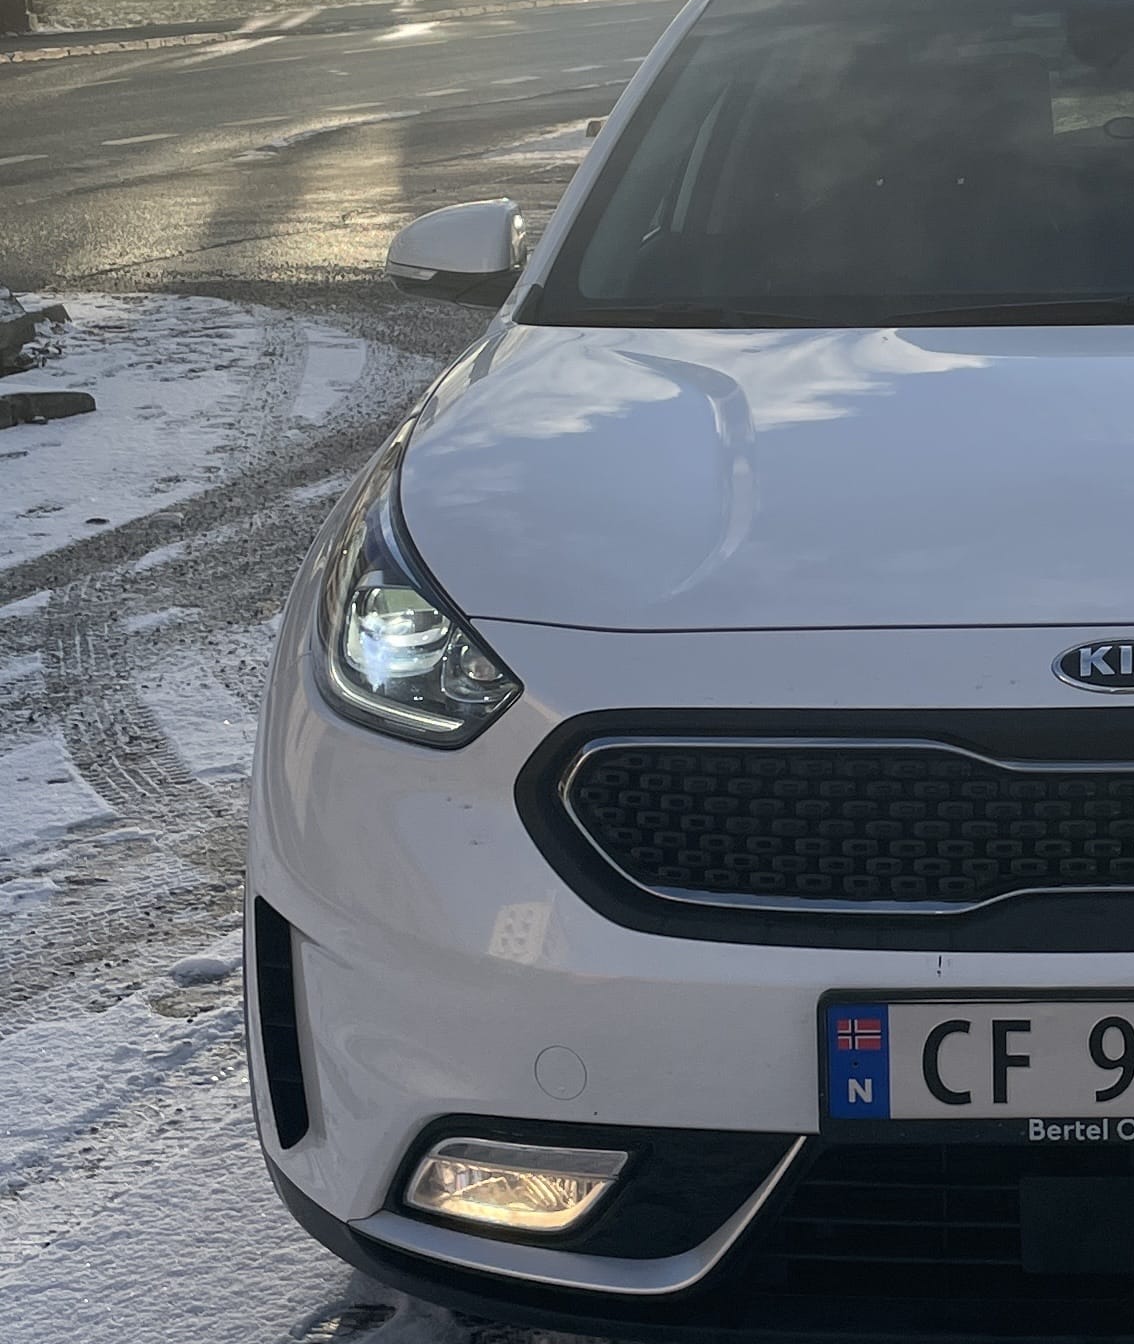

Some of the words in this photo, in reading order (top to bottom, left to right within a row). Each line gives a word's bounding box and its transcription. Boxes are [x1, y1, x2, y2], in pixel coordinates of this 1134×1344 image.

[922, 1018, 1032, 1106] CF
[848, 1078, 873, 1104] N
[1028, 1118, 1109, 1141] Bertel
